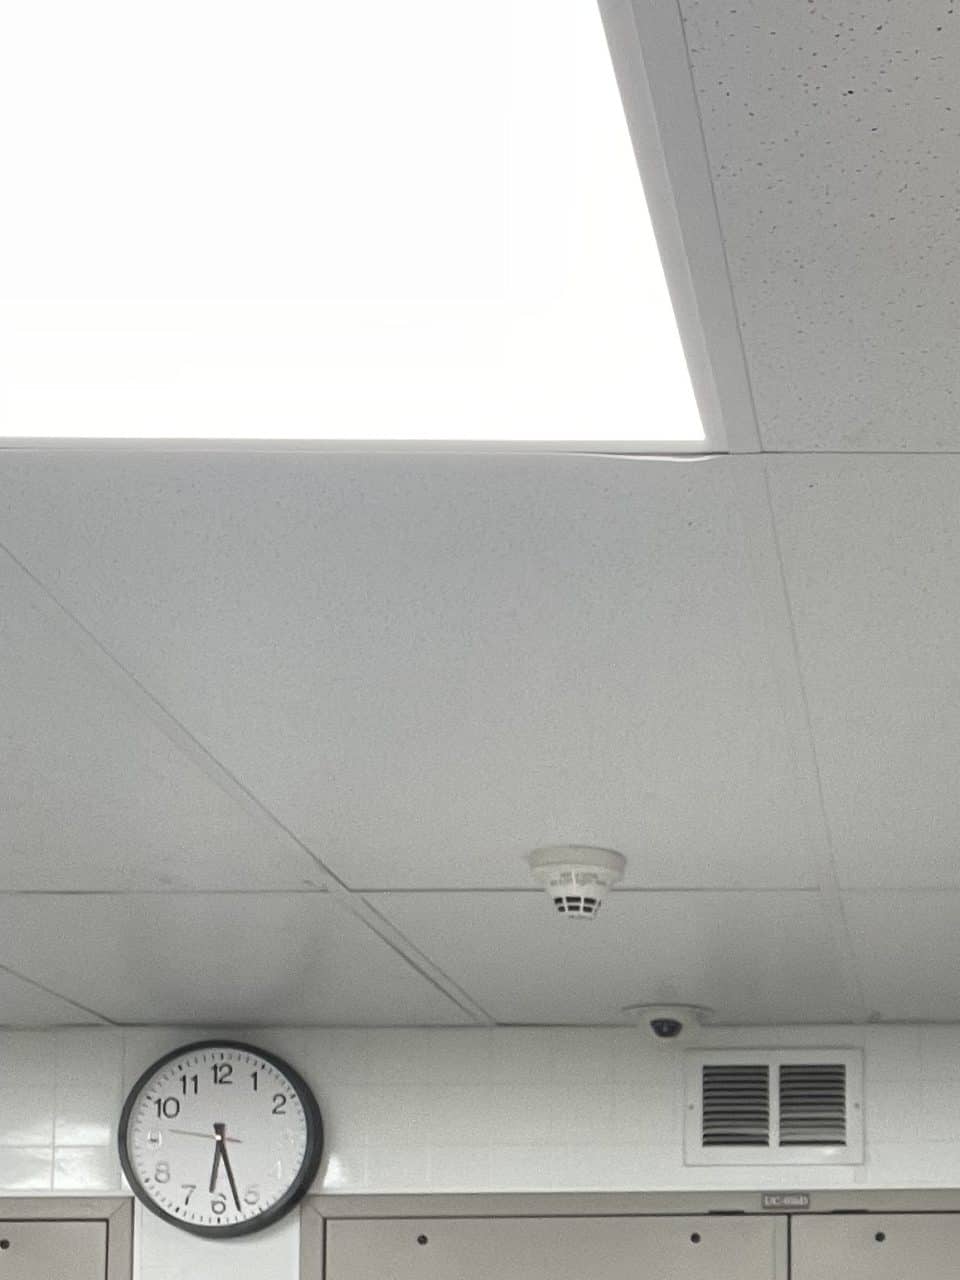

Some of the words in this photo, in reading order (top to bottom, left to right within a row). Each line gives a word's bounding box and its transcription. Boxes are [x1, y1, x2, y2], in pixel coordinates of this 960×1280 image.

[180, 1074, 199, 1095] 11
[212, 1063, 233, 1085] 12
[250, 1071, 258, 1092] 1
[154, 1096, 180, 1118] 10
[271, 1093, 287, 1115] 2
[154, 1161, 170, 1184] 8
[181, 1184, 197, 1206] 7
[210, 1193, 227, 1215] 6
[243, 1183, 261, 1205] 5
